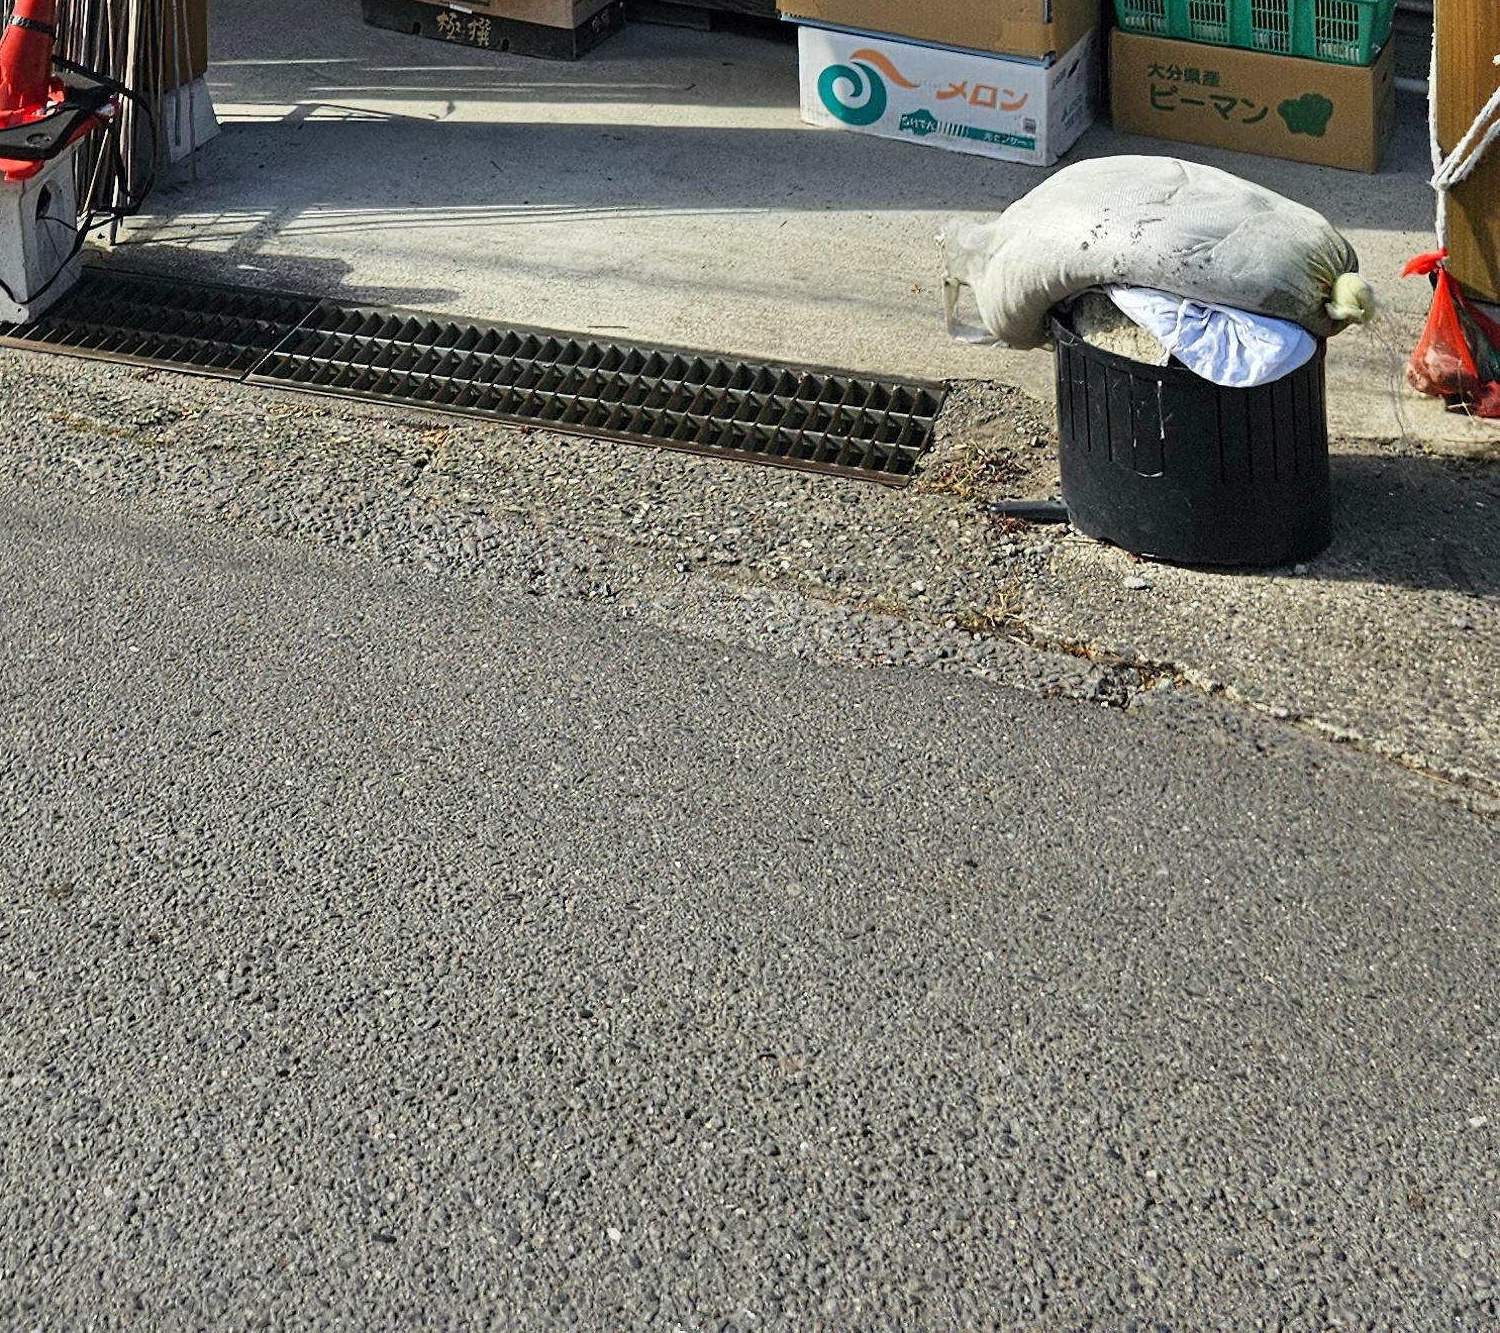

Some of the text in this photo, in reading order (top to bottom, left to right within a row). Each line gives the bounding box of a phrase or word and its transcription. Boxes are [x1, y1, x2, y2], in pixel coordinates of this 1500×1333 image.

[1148, 63, 1220, 87] 大分県産
[935, 79, 1029, 111] メロン
[1150, 83, 1269, 124] ピーマン
